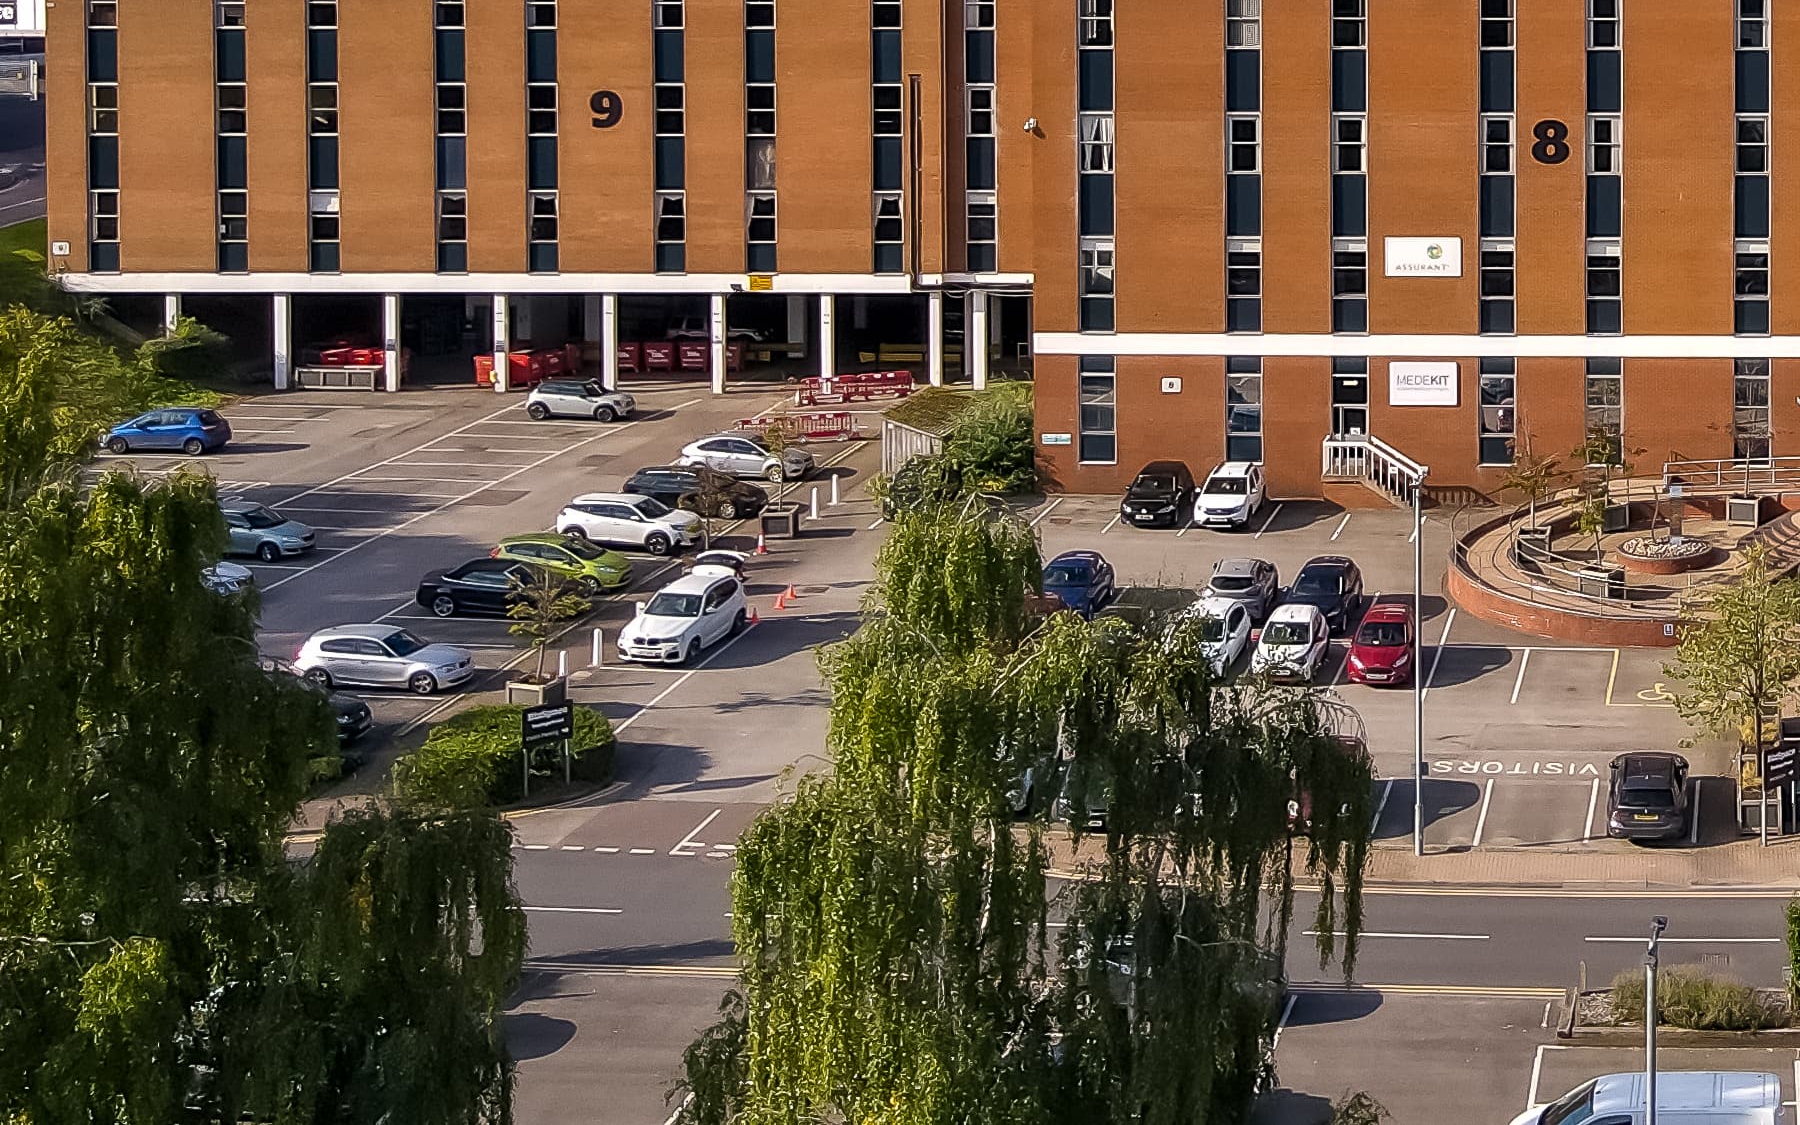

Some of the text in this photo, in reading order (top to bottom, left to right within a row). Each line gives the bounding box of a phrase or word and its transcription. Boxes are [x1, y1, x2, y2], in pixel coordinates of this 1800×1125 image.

[590, 90, 623, 128] 9
[1532, 119, 1570, 165] 8
[1395, 263, 1448, 271] ASSURANT
[1396, 374, 1449, 386] MEDEKIT
[1431, 760, 1599, 775] VISITORS
